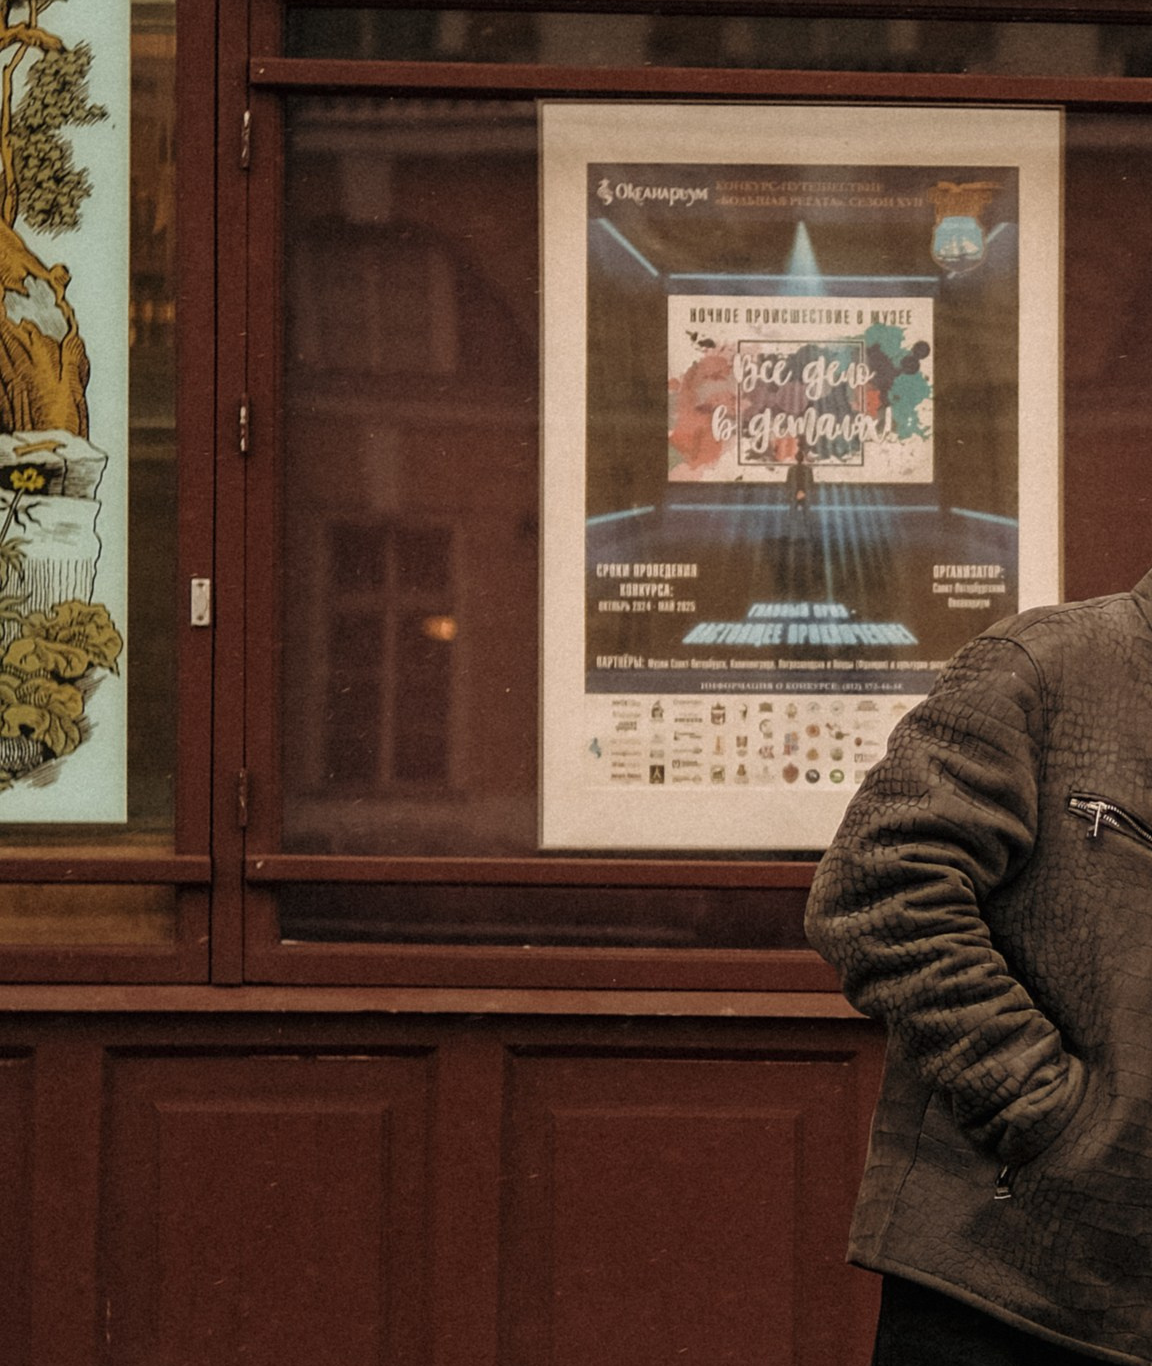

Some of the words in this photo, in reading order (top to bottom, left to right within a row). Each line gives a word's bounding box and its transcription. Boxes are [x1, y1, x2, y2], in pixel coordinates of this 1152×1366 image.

[690, 308, 739, 323] НОЧНОЕ
[745, 308, 850, 325] ПРОИСШЕСТВИЕ
[856, 309, 864, 324] В
[870, 309, 912, 325] МУЗЕЕ
[802, 355, 876, 400] дело
[711, 404, 738, 442] в
[748, 406, 892, 453] деталях!
[596, 563, 630, 578] СРОКИ
[633, 563, 698, 579] ПРОВЕДЕНИЯ
[932, 565, 1005, 579] ОРГАНИЗАТОР:
[619, 583, 674, 597] КОНКУРСА:
[598, 600, 631, 612] ОКТЯБРЬ
[658, 599, 675, 612] МАЙ
[676, 600, 696, 612] 2025
[681, 622, 784, 647] НАСТОЯЩЕЕ
[596, 653, 645, 669] ПАРТНЁРЫ:
[700, 682, 773, 691] ИНФОРМАЦИЯ
